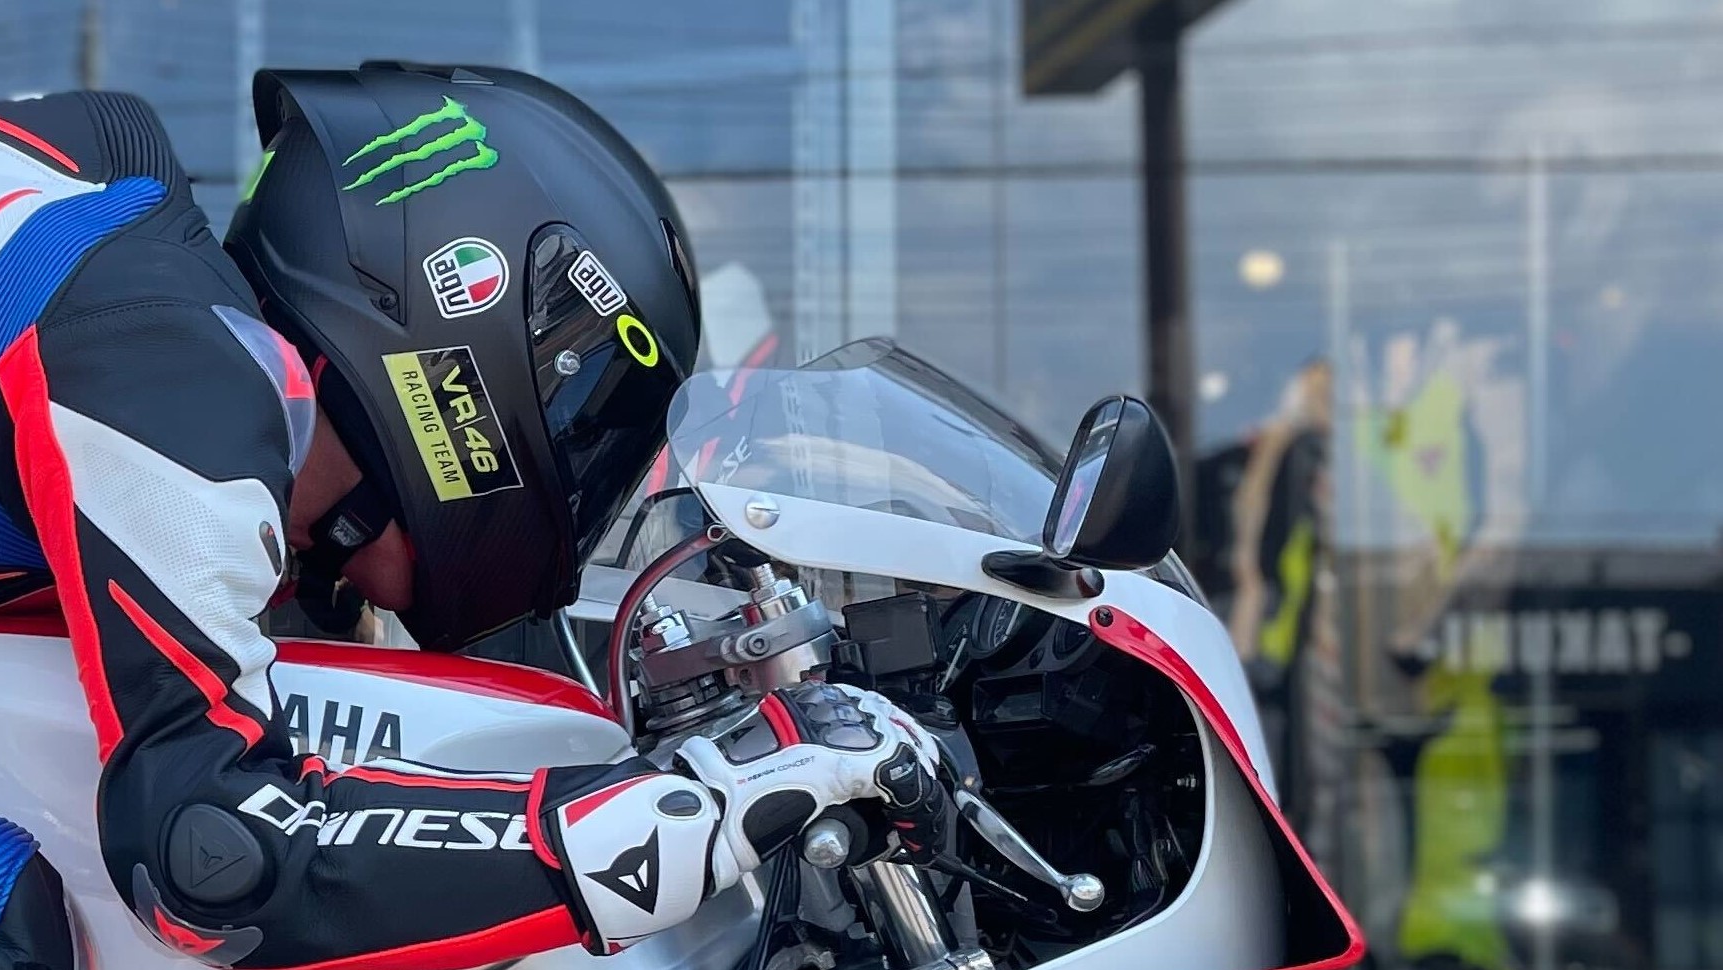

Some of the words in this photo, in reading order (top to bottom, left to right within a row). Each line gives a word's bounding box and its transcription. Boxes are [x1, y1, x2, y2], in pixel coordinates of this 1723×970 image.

[434, 258, 470, 308] agv
[577, 263, 619, 306] agv
[401, 370, 440, 433] RACING
[430, 440, 461, 484] TEAM
